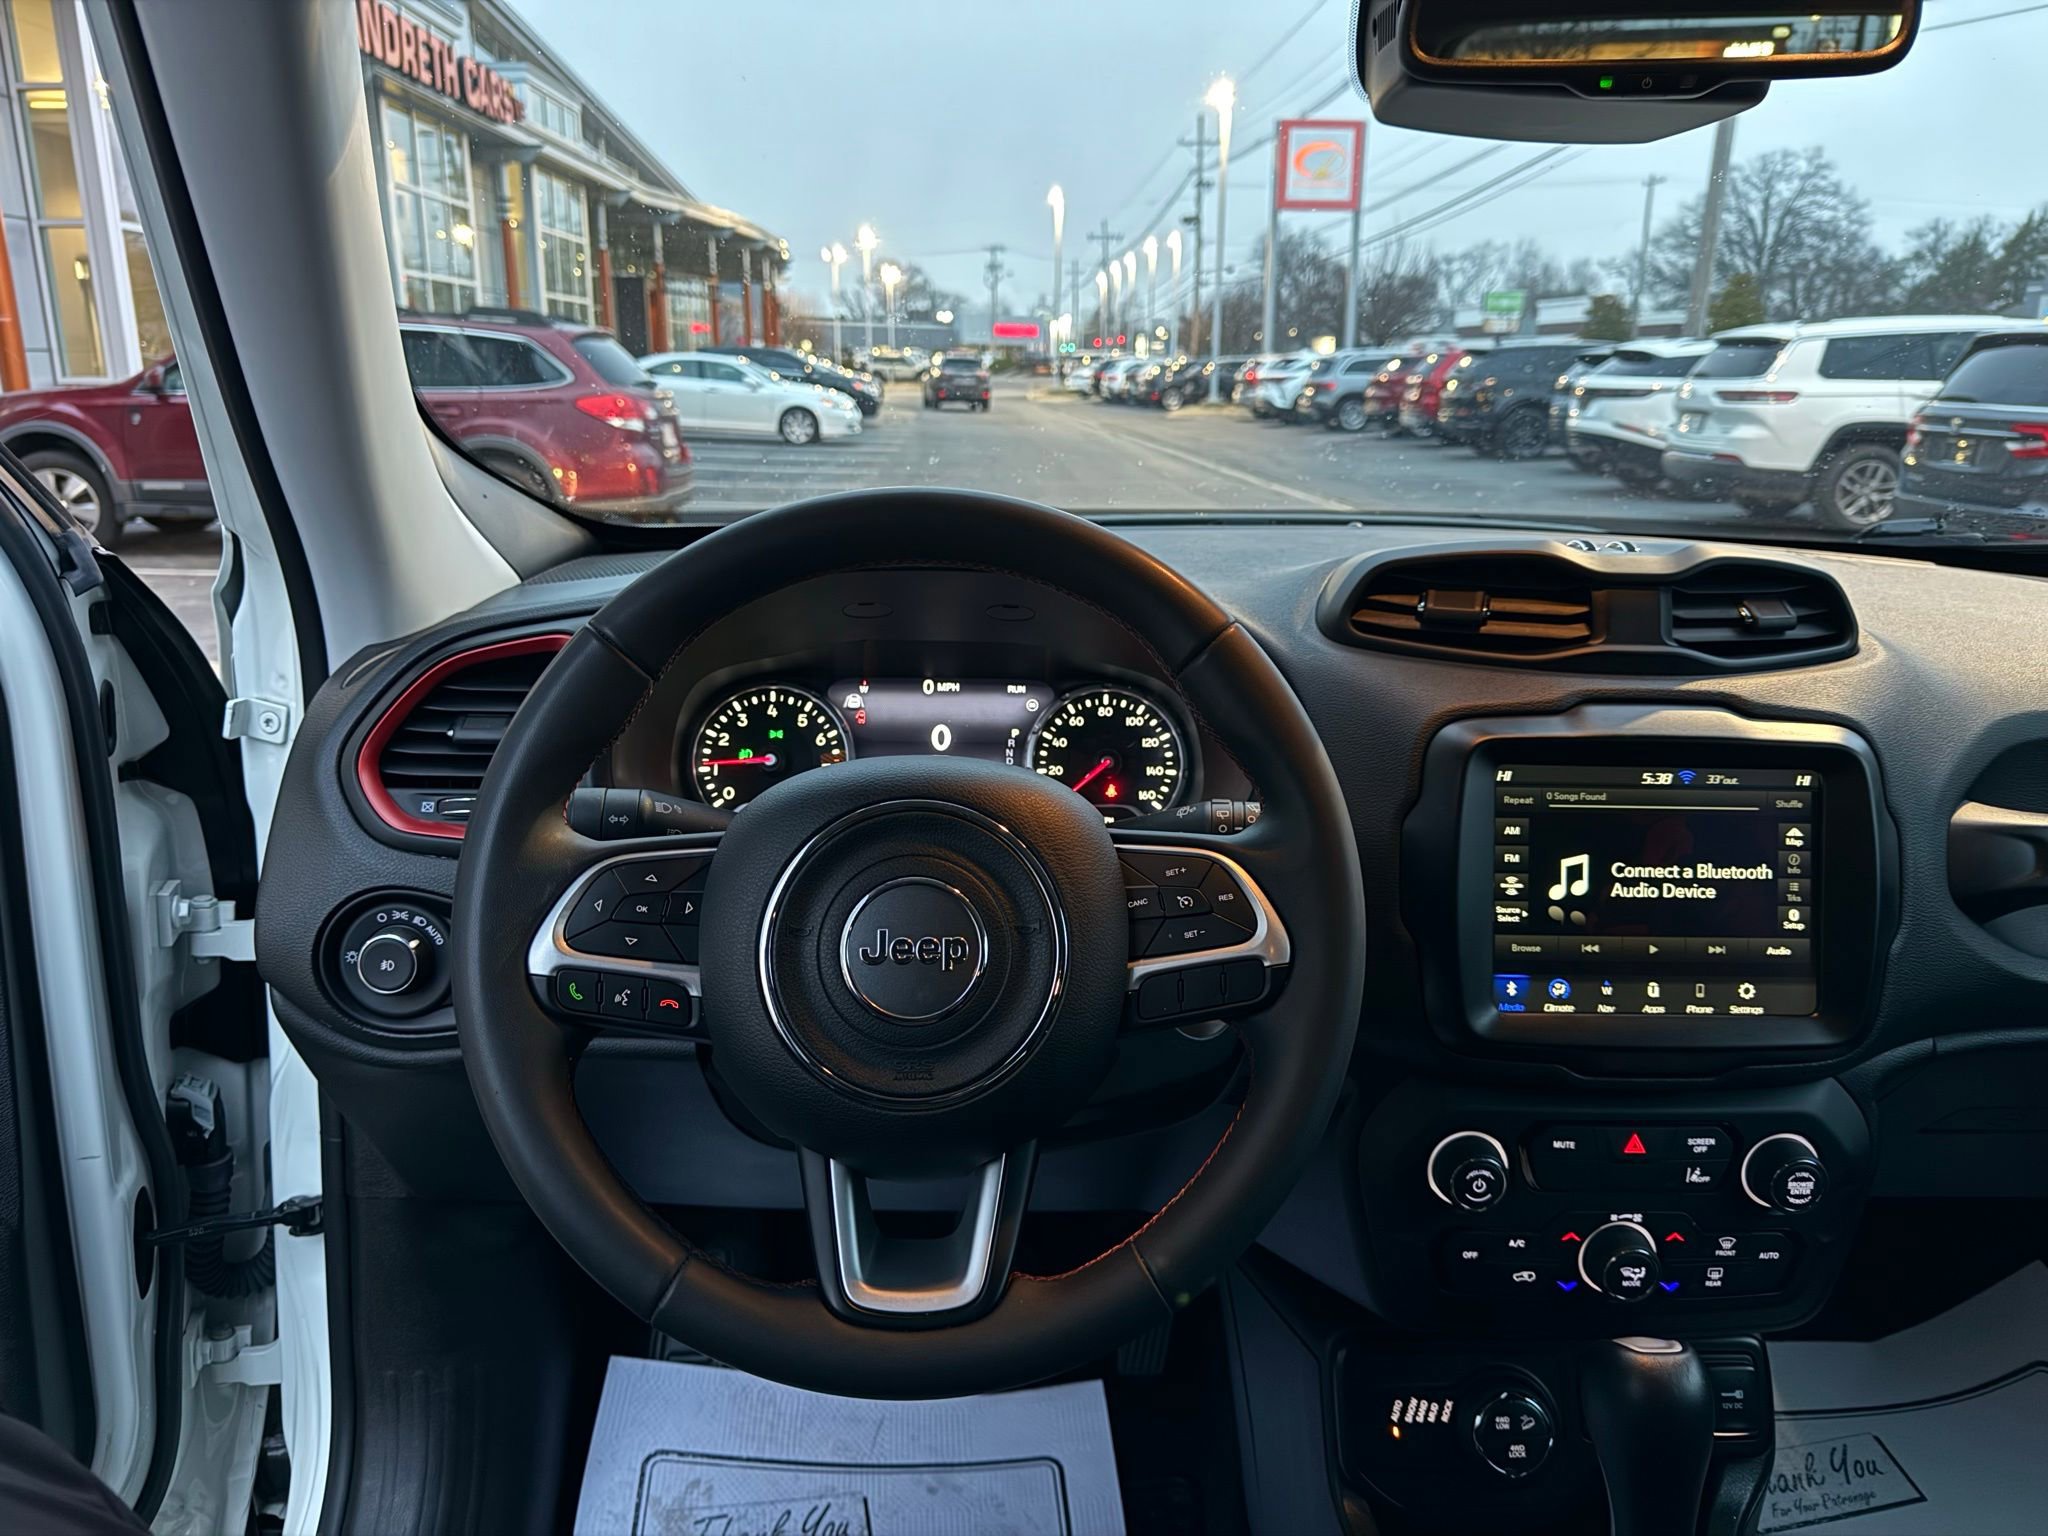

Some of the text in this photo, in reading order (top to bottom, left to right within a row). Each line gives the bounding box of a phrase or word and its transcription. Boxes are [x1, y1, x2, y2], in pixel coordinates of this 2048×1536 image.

[937, 682, 960, 692] MPH
[1007, 685, 1026, 694] RUN
[767, 706, 778, 717] 4
[1097, 707, 1113, 717] 80
[737, 714, 748, 727] 3
[797, 715, 808, 727] 5
[1069, 717, 1084, 727] 60
[1125, 717, 1144, 727] 100
[930, 723, 951, 751] 0
[1011, 728, 1020, 738] P
[718, 734, 730, 747] 2
[815, 733, 827, 747] 6
[1007, 739, 1016, 748] R
[1052, 738, 1068, 748] 40
[1142, 738, 1159, 748] 120
[1005, 749, 1014, 757] N
[713, 764, 718, 776] 1
[1048, 765, 1064, 776] 20
[1146, 766, 1164, 776] 140
[1496, 771, 1512, 782] HI
[1640, 772, 1673, 785] 5:38
[1795, 775, 1812, 786] HI
[722, 786, 735, 800] 0
[1138, 790, 1157, 800] 160
[1546, 792, 1607, 802] 0 Songs Found
[1503, 795, 1534, 805] Repeat
[1775, 800, 1803, 809] Shuffle
[1504, 826, 1521, 835] AM
[1504, 854, 1520, 863] FM
[1165, 868, 1179, 877] SET
[1611, 862, 1773, 880] Connect a Bluetooth
[1611, 883, 1717, 899] Audio Device
[1218, 893, 1234, 902] RES
[1127, 898, 1149, 908] CANC
[636, 905, 648, 913] OK
[1496, 906, 1521, 914] Source
[1497, 914, 1520, 923] Select
[1783, 921, 1806, 931] Setup
[425, 925, 444, 945] AUTO
[1184, 929, 1198, 939] SET
[859, 928, 969, 971] Jeep
[1511, 943, 1541, 953] Browse
[1766, 946, 1792, 957] Audio
[1498, 1003, 1526, 1013] Media
[1543, 1003, 1575, 1013] Climate
[1597, 1003, 1616, 1013] Nav
[1642, 1004, 1666, 1014] Apps
[1686, 1004, 1714, 1014] Phone
[1729, 1004, 1764, 1015] Settings
[1553, 1140, 1575, 1149] MUTE
[1693, 1145, 1708, 1153] OFF
[1509, 1239, 1526, 1248] A/C
[1462, 1251, 1478, 1259] OFF
[1829, 1443, 1885, 1485] You
[1771, 1501, 1792, 1518] For
[1793, 1497, 1820, 1515] Your
